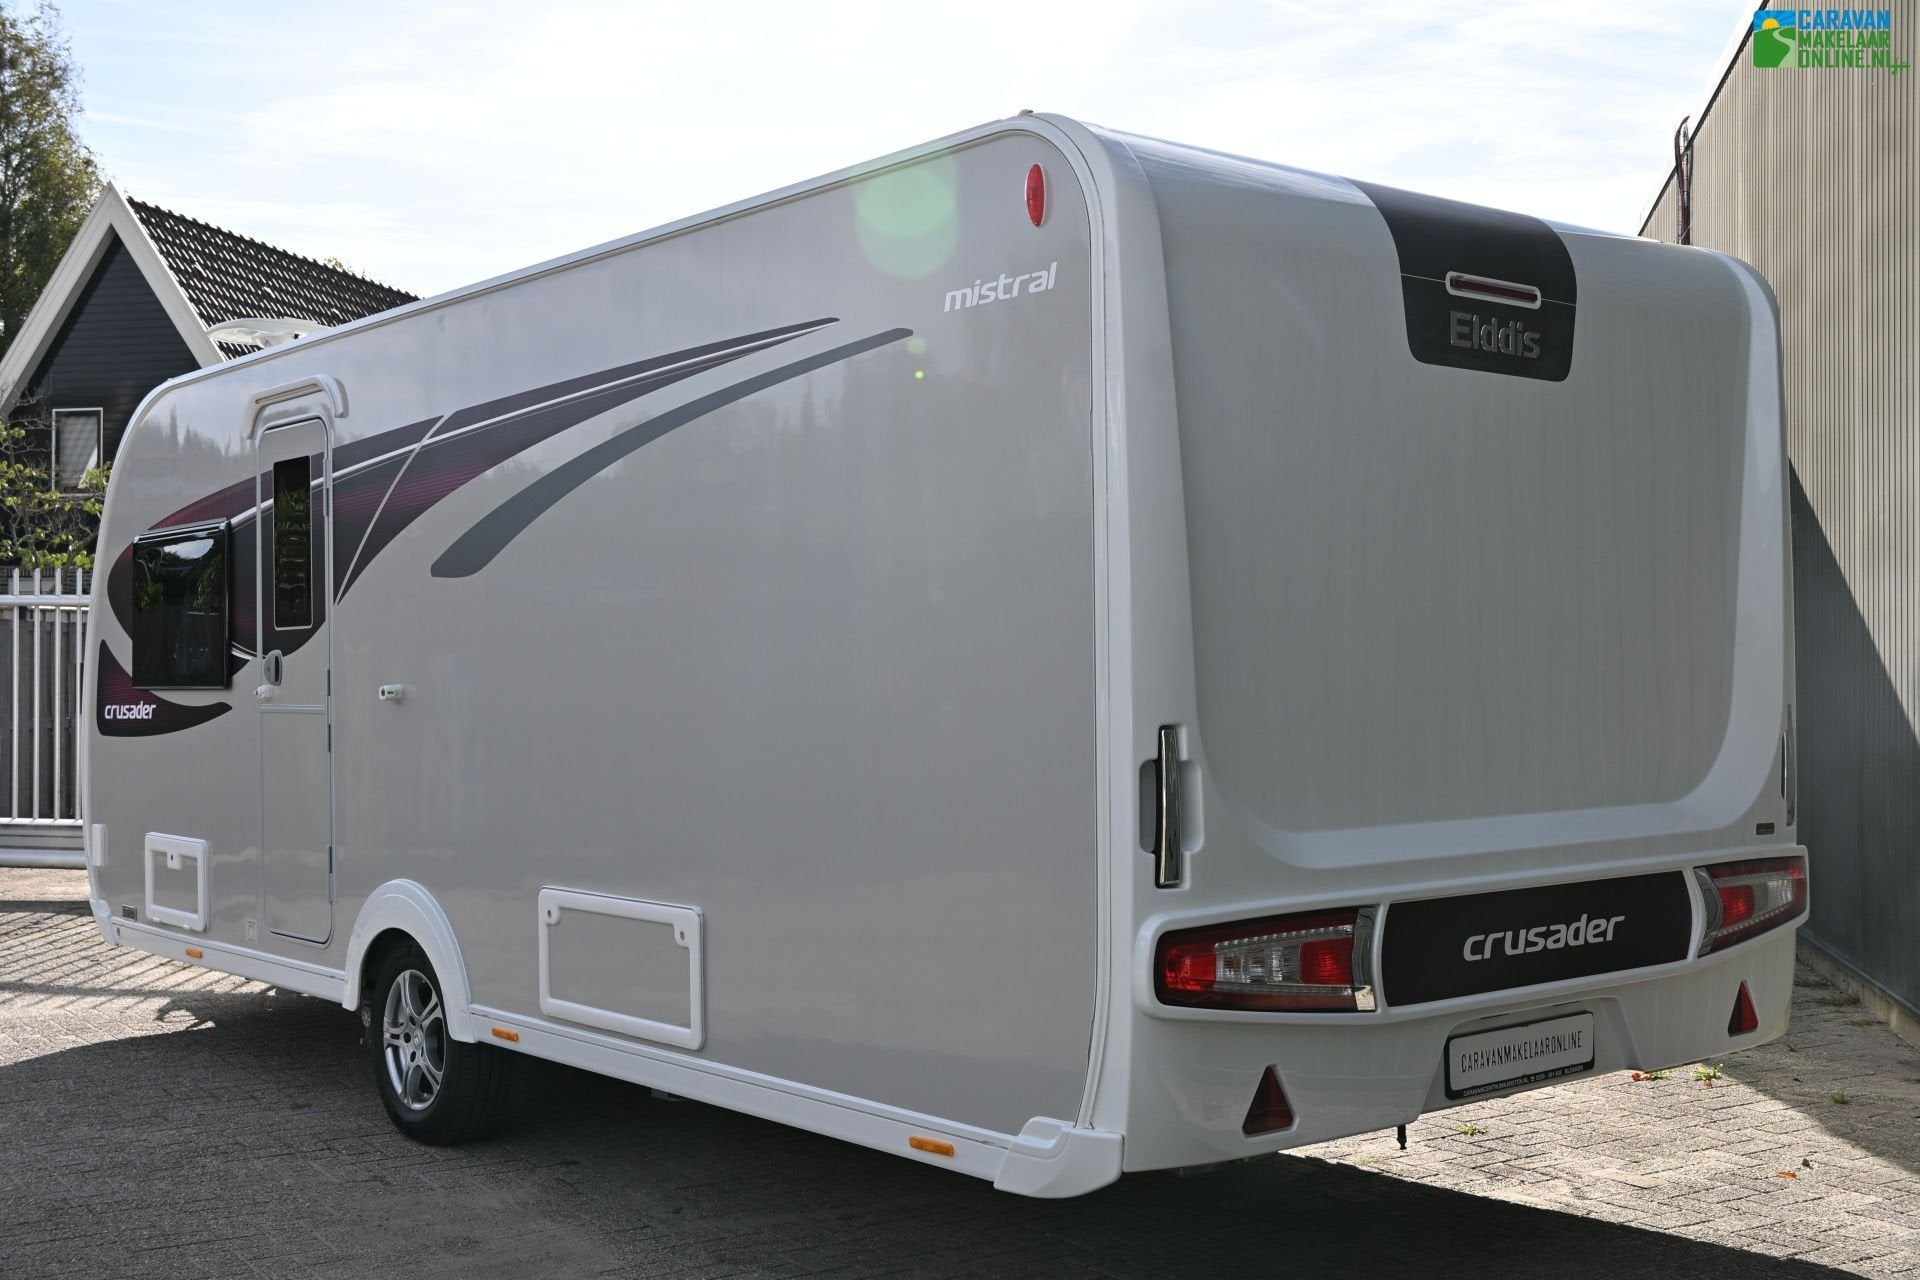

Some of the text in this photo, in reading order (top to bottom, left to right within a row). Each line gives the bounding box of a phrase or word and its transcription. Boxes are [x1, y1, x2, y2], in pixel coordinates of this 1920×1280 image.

[944, 261, 1058, 312] mistral
[1450, 310, 1541, 358] Elddis
[104, 700, 157, 719] crusader
[1463, 913, 1625, 962] crusader
[1461, 1031, 1583, 1073] CARAVANMAKELAARONLINE
